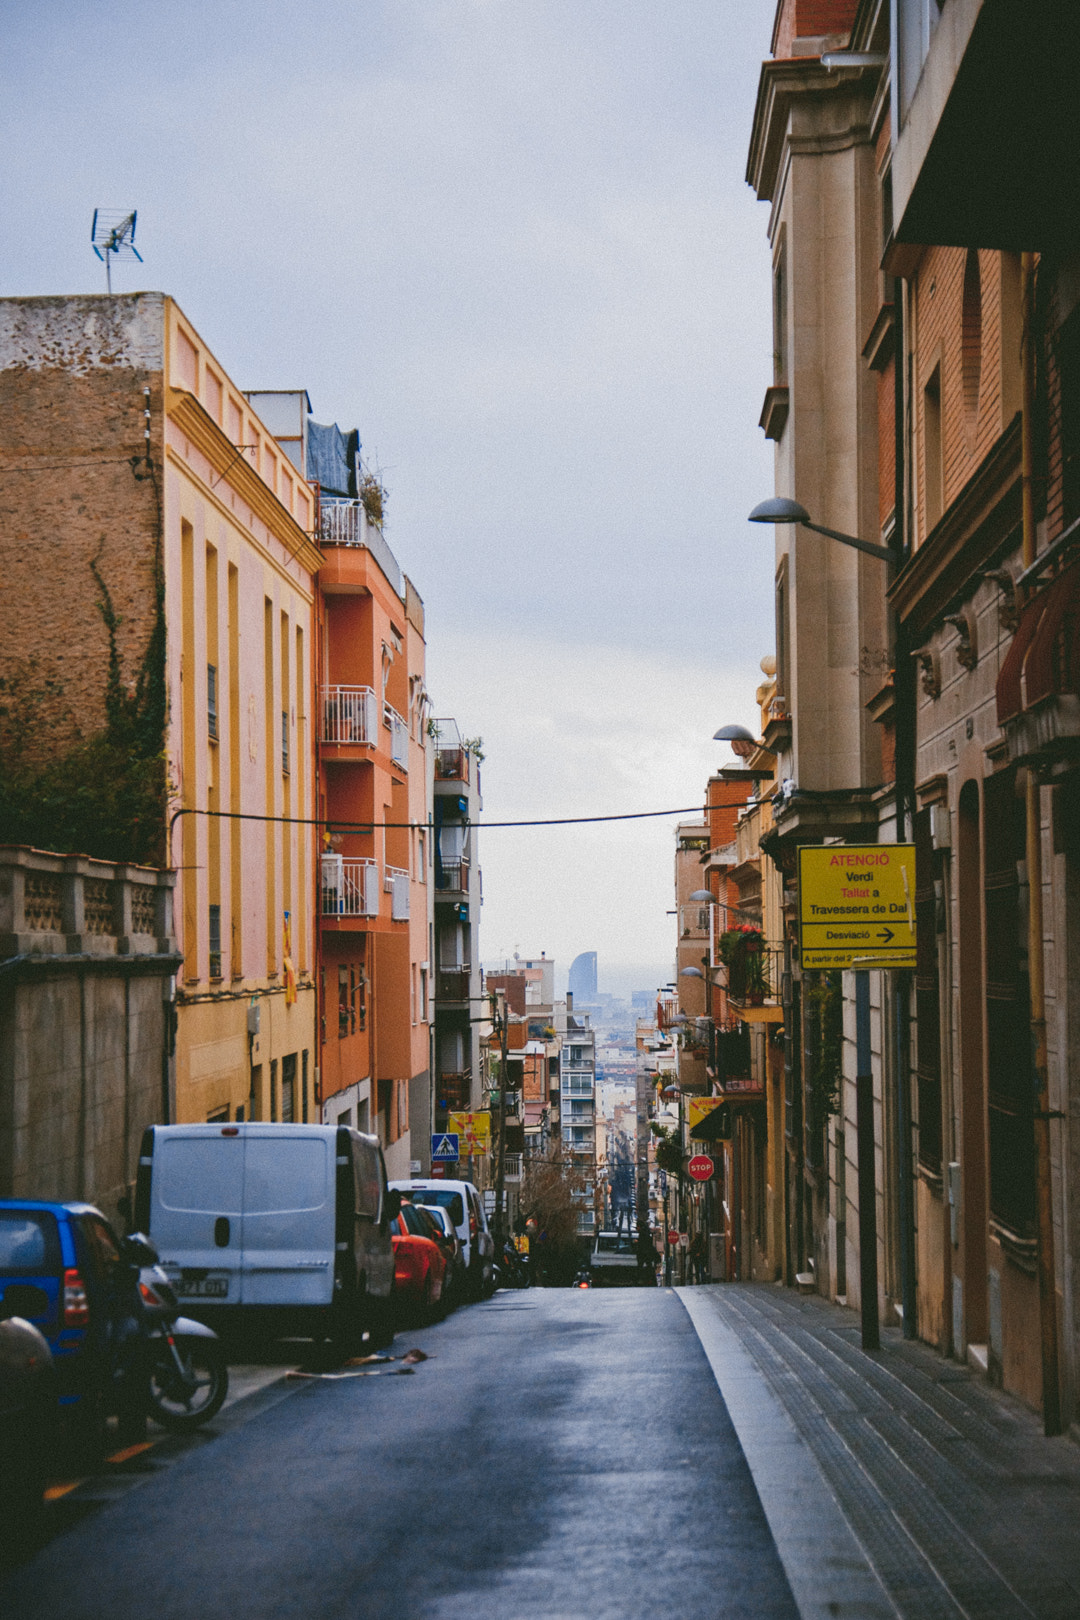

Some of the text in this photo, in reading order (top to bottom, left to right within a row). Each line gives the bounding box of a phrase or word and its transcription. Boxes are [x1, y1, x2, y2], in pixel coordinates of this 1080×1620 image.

[829, 851, 890, 867] ATENCIÓ
[846, 872, 874, 882] Verdi
[841, 888, 880, 898] Tallat a
[810, 903, 909, 915] Travessera de Dal
[826, 930, 870, 940] Desviació
[812, 955, 832, 963] partir
